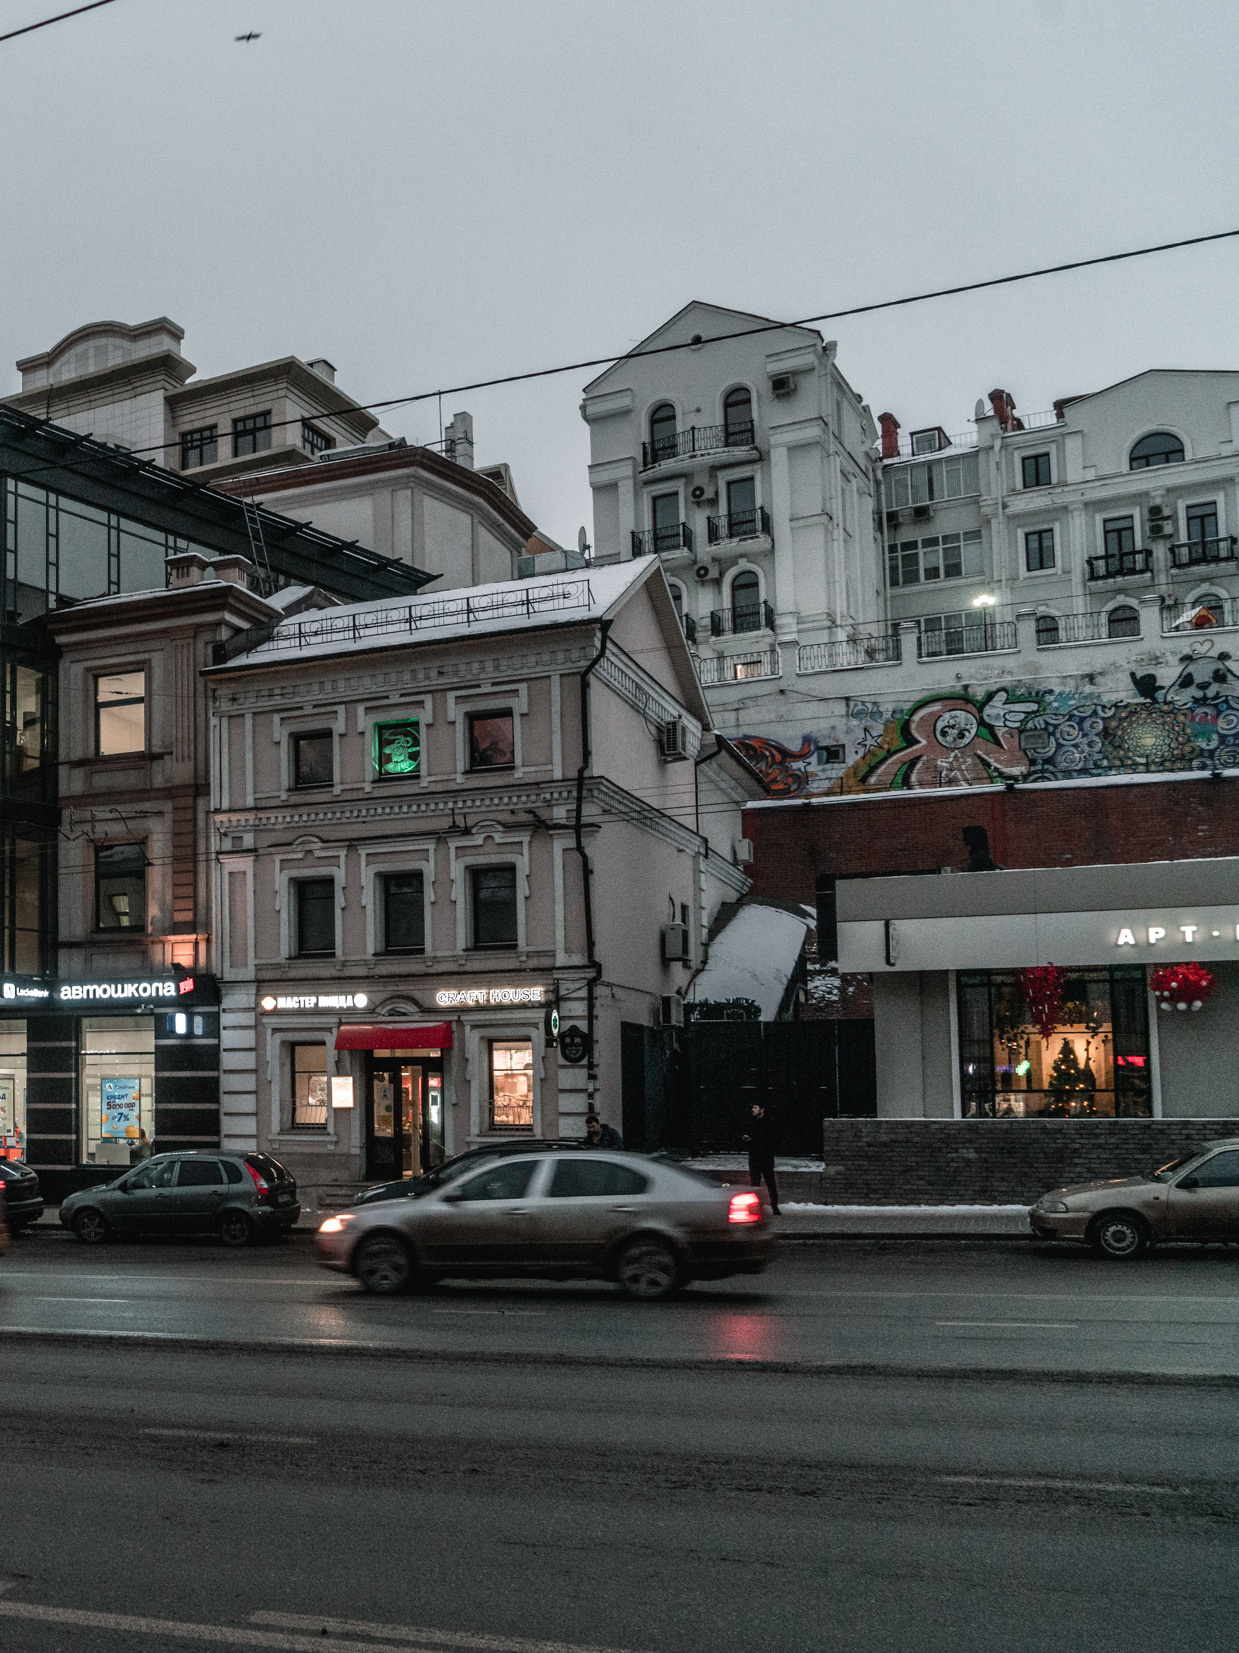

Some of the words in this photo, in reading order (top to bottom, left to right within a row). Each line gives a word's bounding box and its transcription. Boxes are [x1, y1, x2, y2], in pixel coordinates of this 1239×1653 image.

[60, 981, 176, 1000] автошкола
[436, 990, 487, 1005] CRAFT
[489, 987, 542, 1003] HOUSE
[277, 996, 317, 1009] МАСТЕР
[106, 1101, 112, 1110] 5
